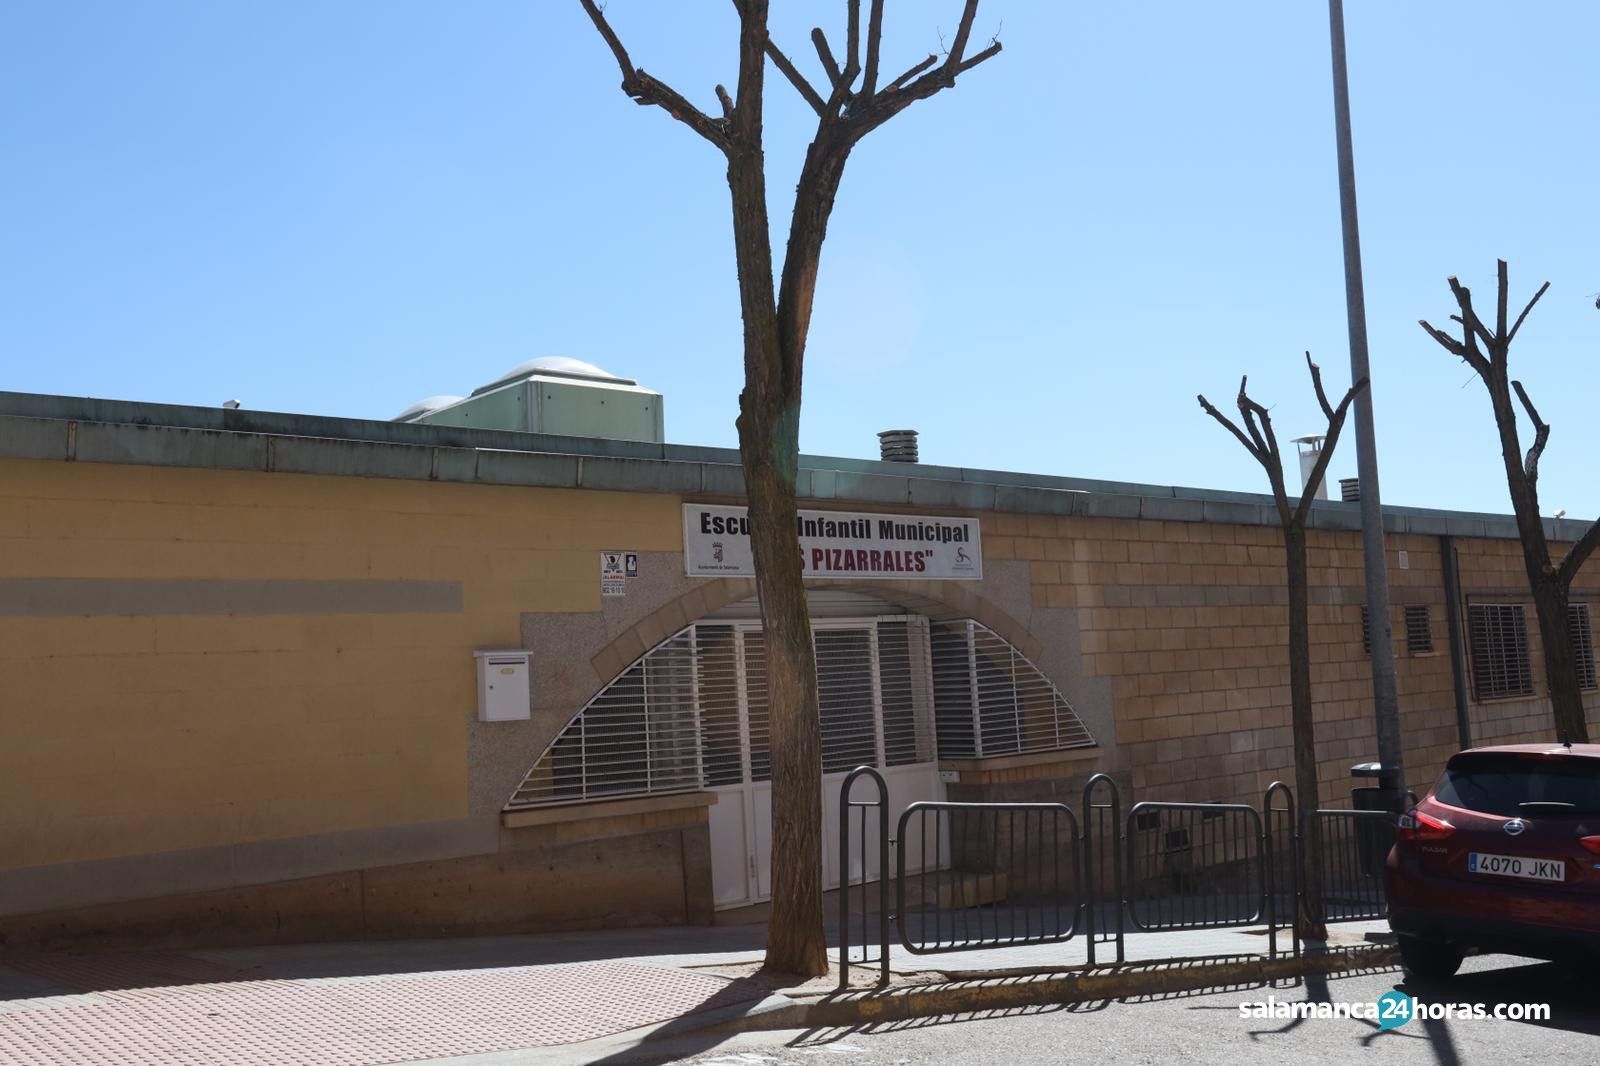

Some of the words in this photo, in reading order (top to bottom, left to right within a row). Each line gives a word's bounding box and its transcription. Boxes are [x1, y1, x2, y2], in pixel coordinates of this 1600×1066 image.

[700, 512, 751, 535] Escu
[797, 515, 871, 539] Infantil
[879, 519, 969, 544] Municipal
[812, 548, 933, 573] PIZARRALES"
[1480, 858, 1521, 874] 4070
[1528, 861, 1561, 879] JKN
